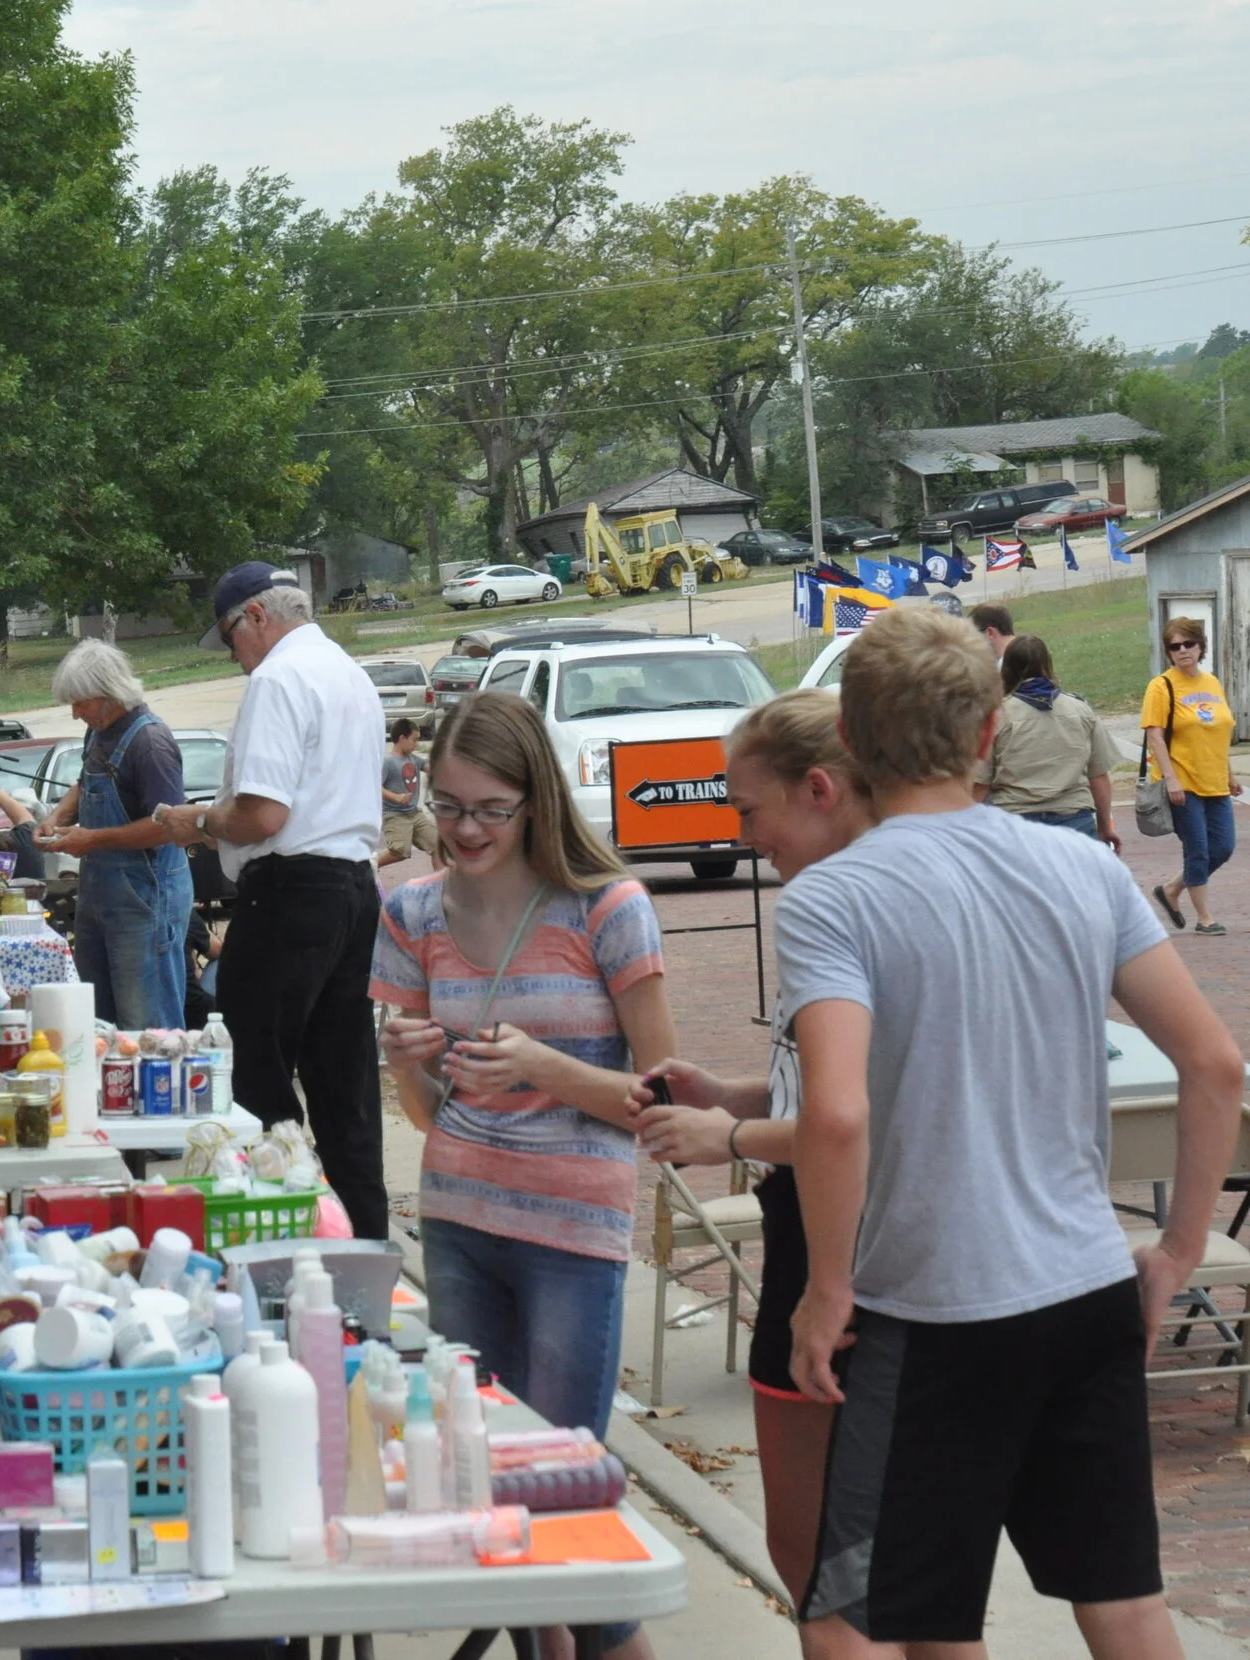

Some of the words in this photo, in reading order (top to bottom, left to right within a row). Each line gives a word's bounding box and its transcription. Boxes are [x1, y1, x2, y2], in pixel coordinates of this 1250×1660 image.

[683, 584, 695, 594] 30
[658, 786, 673, 800] TO
[675, 781, 727, 800] TRAINS
